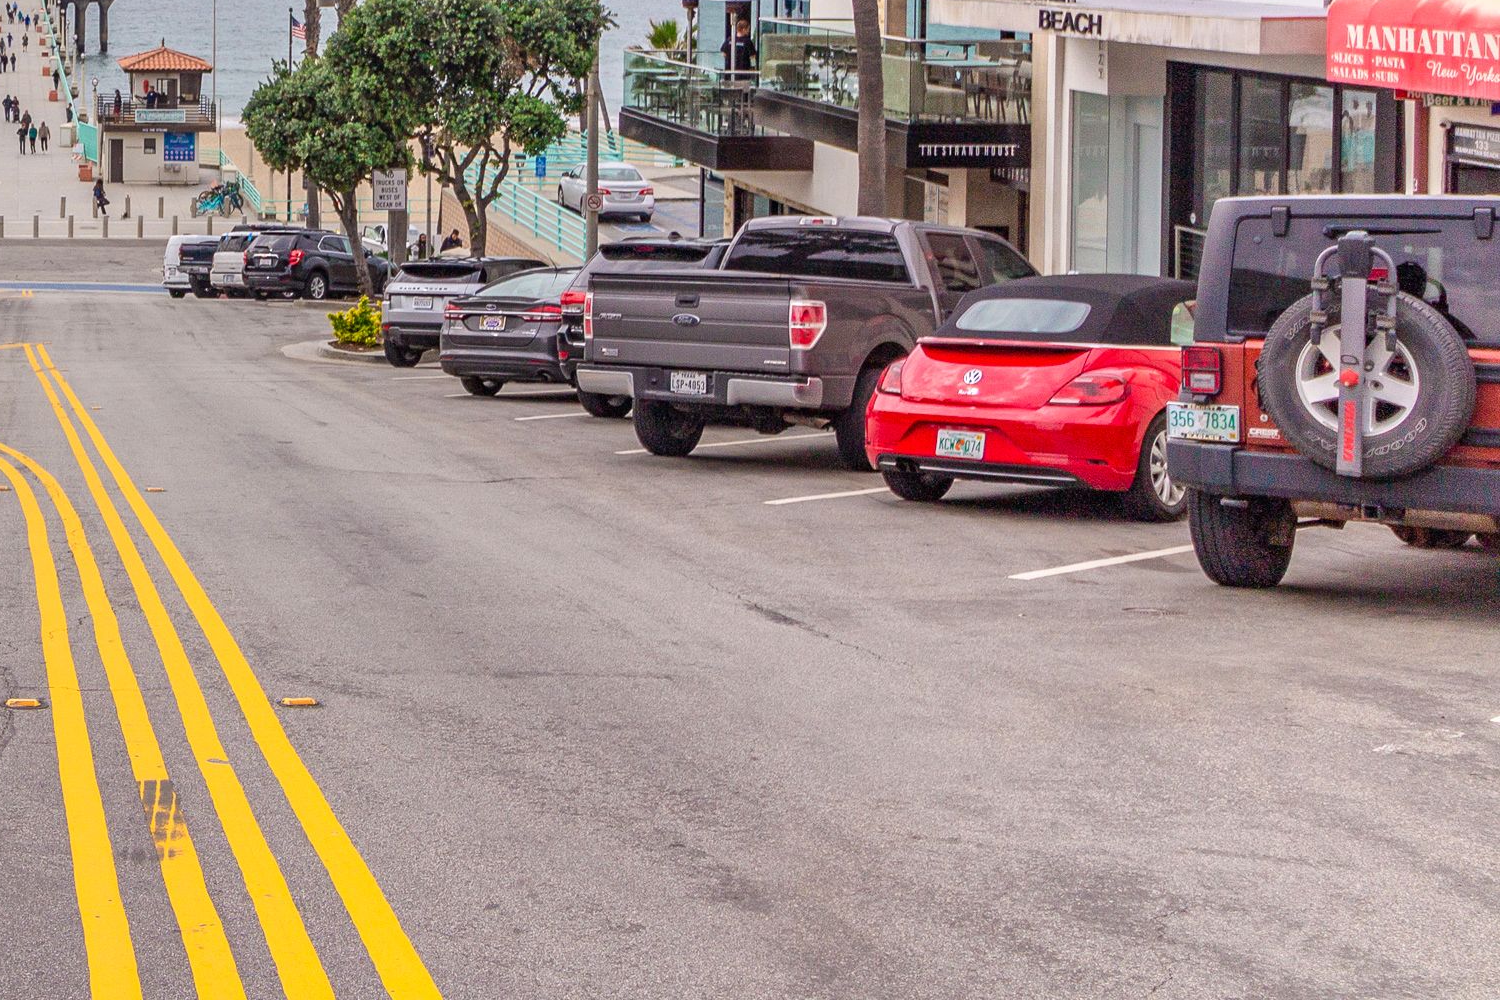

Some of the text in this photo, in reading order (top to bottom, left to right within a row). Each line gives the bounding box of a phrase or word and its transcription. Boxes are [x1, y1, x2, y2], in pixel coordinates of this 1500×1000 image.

[1039, 10, 1102, 36] BEACH
[1346, 24, 1500, 60] MANHATTAN
[1332, 52, 1405, 69] SLICES PASTA
[1332, 67, 1399, 83] SALADS SUBS
[1426, 60, 1458, 79] New
[1426, 93, 1453, 106] Beer
[919, 143, 1015, 157] THE STRAND HOUSE
[1474, 140, 1489, 151] 133
[1170, 409, 1236, 431] 356 7834
[938, 437, 981, 453] KCW 074
